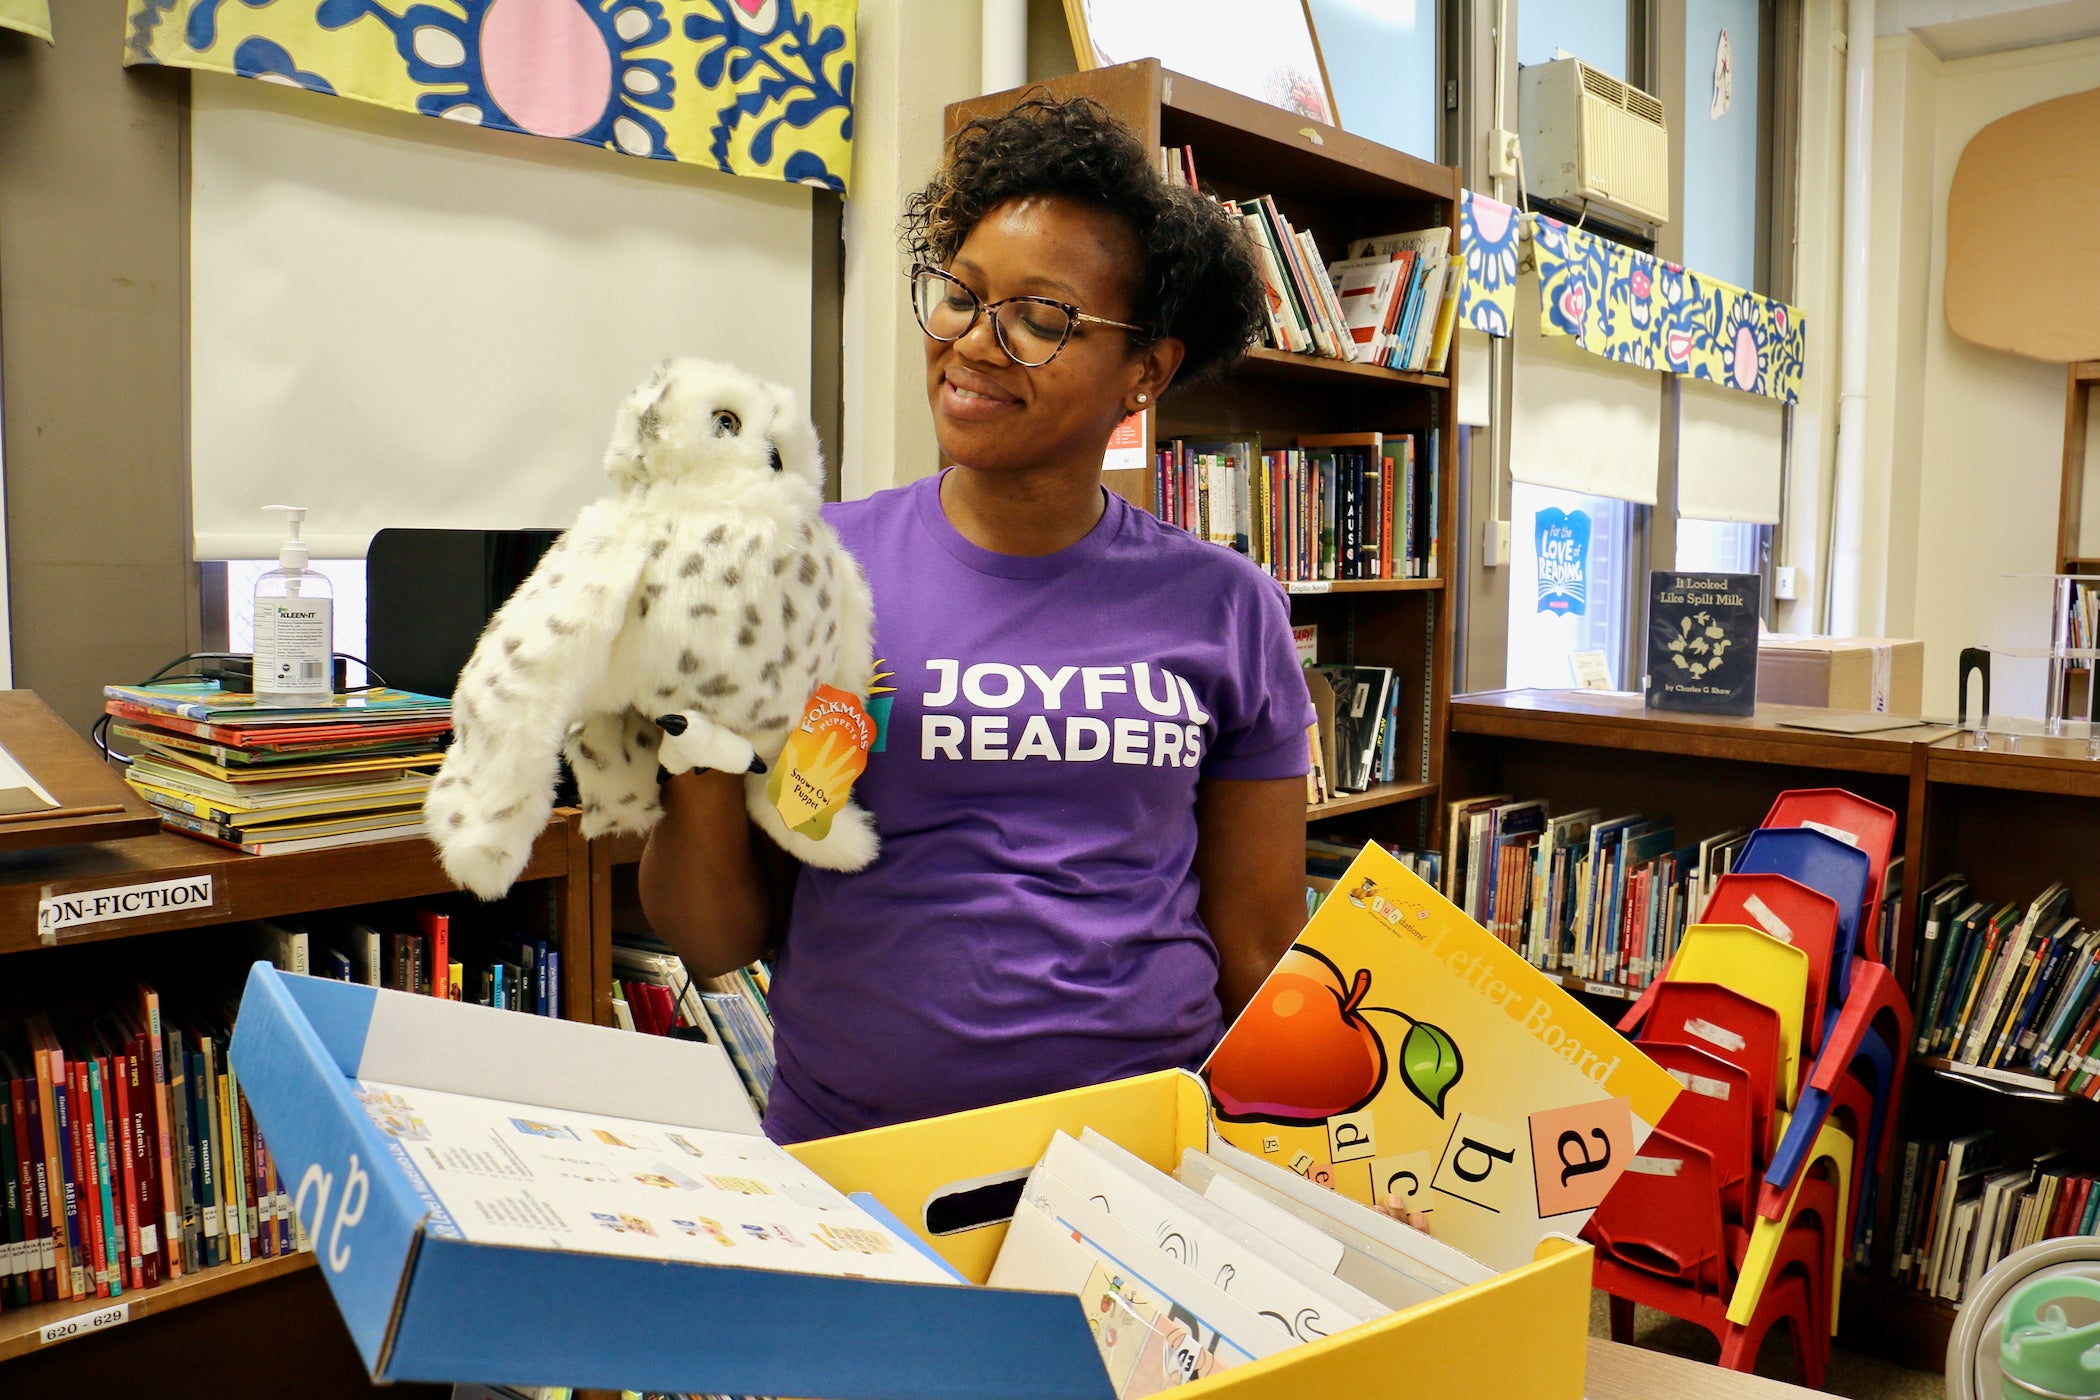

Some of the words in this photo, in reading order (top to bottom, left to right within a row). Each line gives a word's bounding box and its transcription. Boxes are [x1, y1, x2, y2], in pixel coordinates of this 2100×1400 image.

[1386, 514, 1392, 522] UP
[1550, 525, 1560, 536] For
[1562, 525, 1572, 538] the
[1542, 530, 1574, 564] LOVE
[1574, 543, 1582, 557] of
[1538, 558, 1582, 582] READING
[1676, 578, 1686, 590] It
[1686, 578, 1728, 590] Looked
[1660, 591, 1684, 604] Like
[1686, 592, 1713, 606] Spilt
[1716, 594, 1744, 606] Milk
[922, 658, 1210, 726] JOYFUL
[1664, 684, 1674, 692] by
[1675, 684, 1702, 694] Charles
[1710, 685, 1731, 695] Shaw
[801, 702, 869, 750] FOLKMANIS
[819, 716, 858, 740] PUPPETS
[921, 714, 1201, 768] READERS
[790, 768, 815, 794] Snowy
[816, 788, 830, 806] Owl
[794, 784, 818, 810] Puppet
[1426, 924, 1522, 1016] Letter
[1522, 996, 1620, 1089] Board
[155, 1051, 163, 1083] ASTHMA
[130, 1055, 138, 1069] HOT
[135, 1112, 144, 1158] Pandemics
[1266, 1138, 1277, 1150] g
[1335, 1122, 1370, 1152] d
[22, 1160, 30, 1184] Family
[90, 1150, 98, 1186] Technician
[202, 1140, 212, 1185] PHOBIAS
[1294, 1154, 1308, 1168] f
[1453, 1136, 1516, 1183] b
[1557, 1127, 1612, 1188] a
[36, 1162, 48, 1218] SCHIZOPHRENIA
[1314, 1171, 1330, 1184] e
[1388, 1170, 1419, 1196] c
[24, 1184, 34, 1218] Therapy
[65, 1182, 77, 1217] RABIES
[47, 1323, 78, 1340] 620
[93, 1310, 122, 1326] 629
